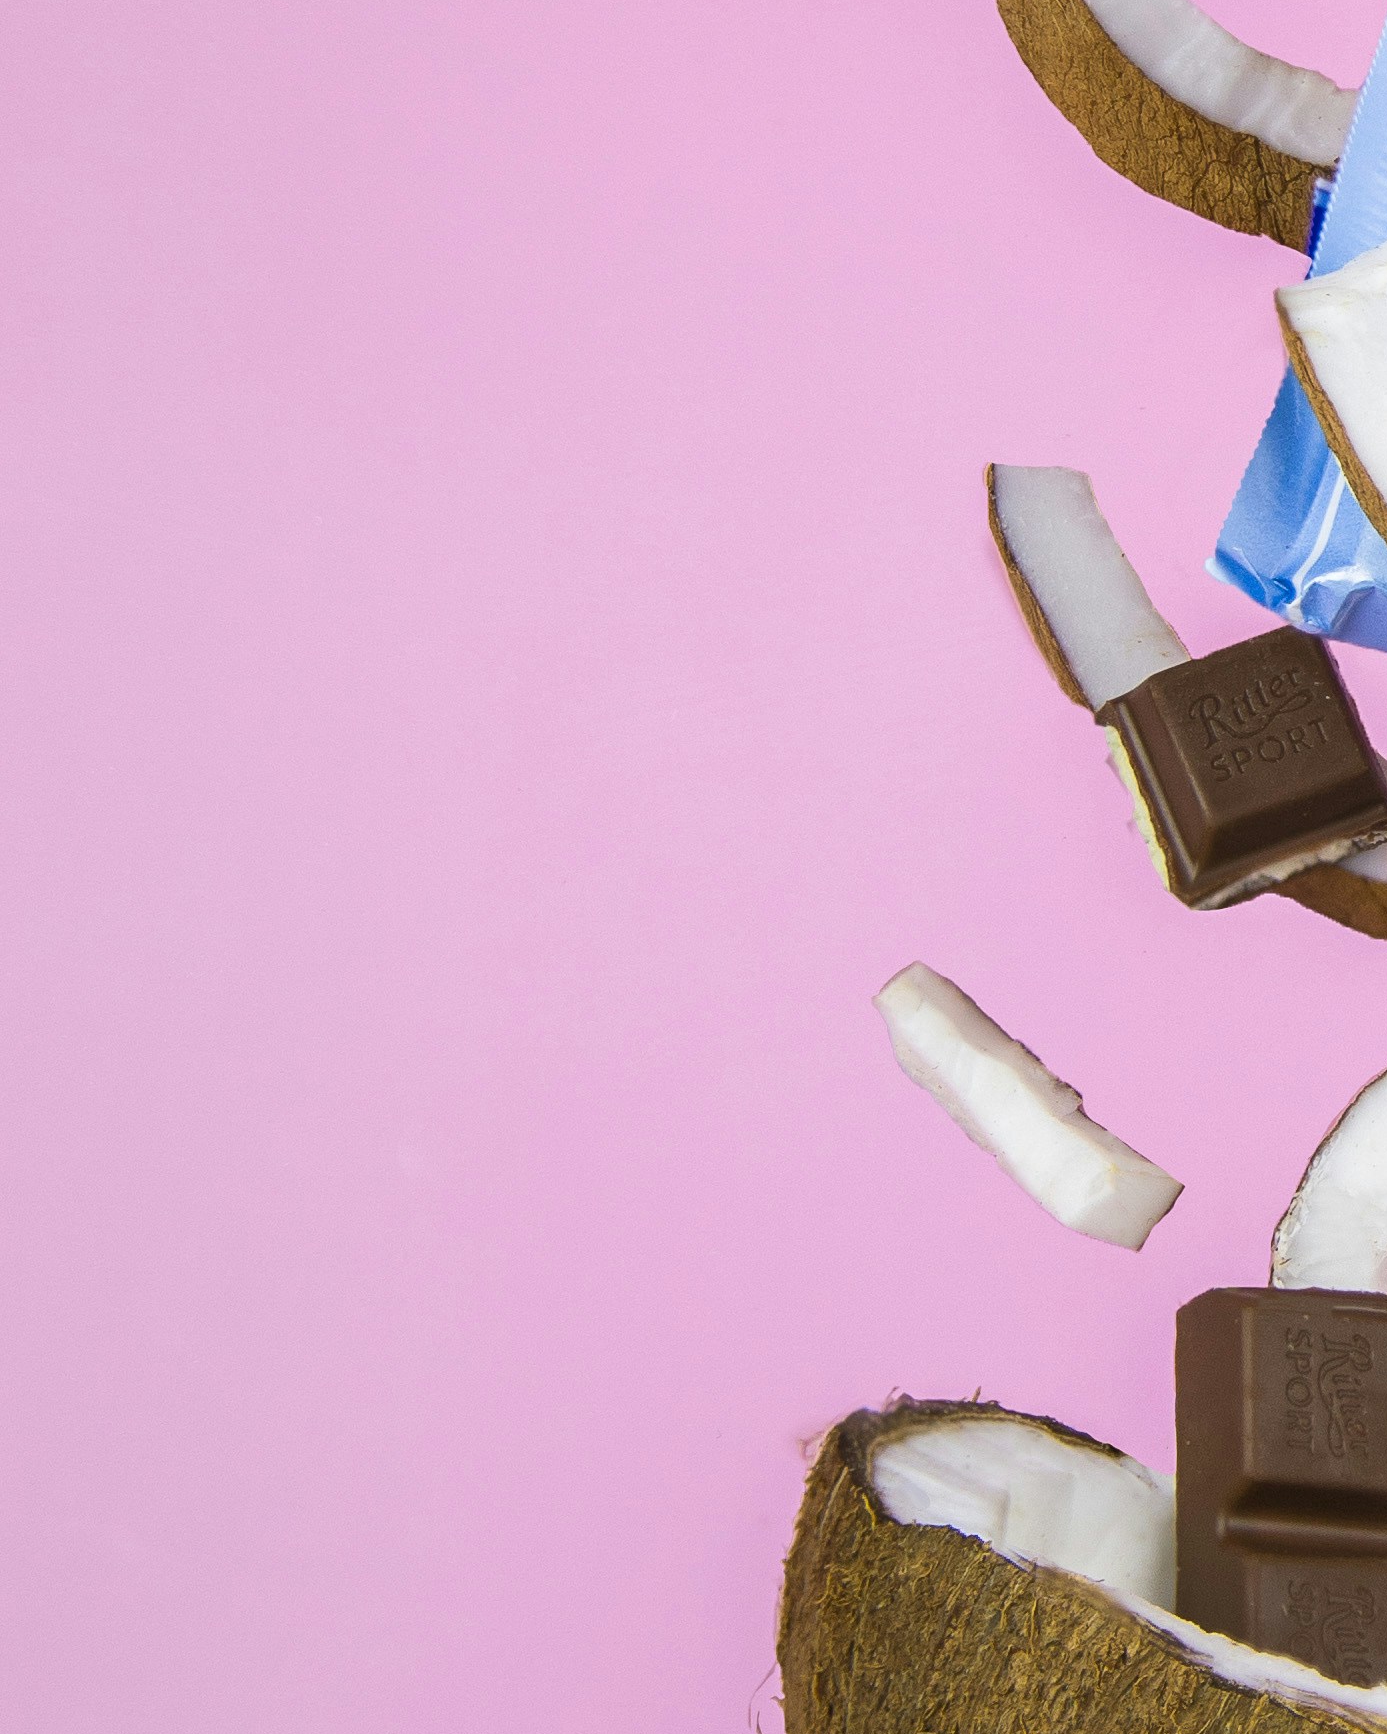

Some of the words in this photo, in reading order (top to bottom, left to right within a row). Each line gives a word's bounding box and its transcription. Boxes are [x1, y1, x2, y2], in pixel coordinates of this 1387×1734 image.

[1188, 668, 1314, 751] Ritter
[1209, 717, 1331, 782] SPORT
[1284, 1326, 1316, 1456] SPORT
[1317, 1331, 1374, 1460] Ritter
